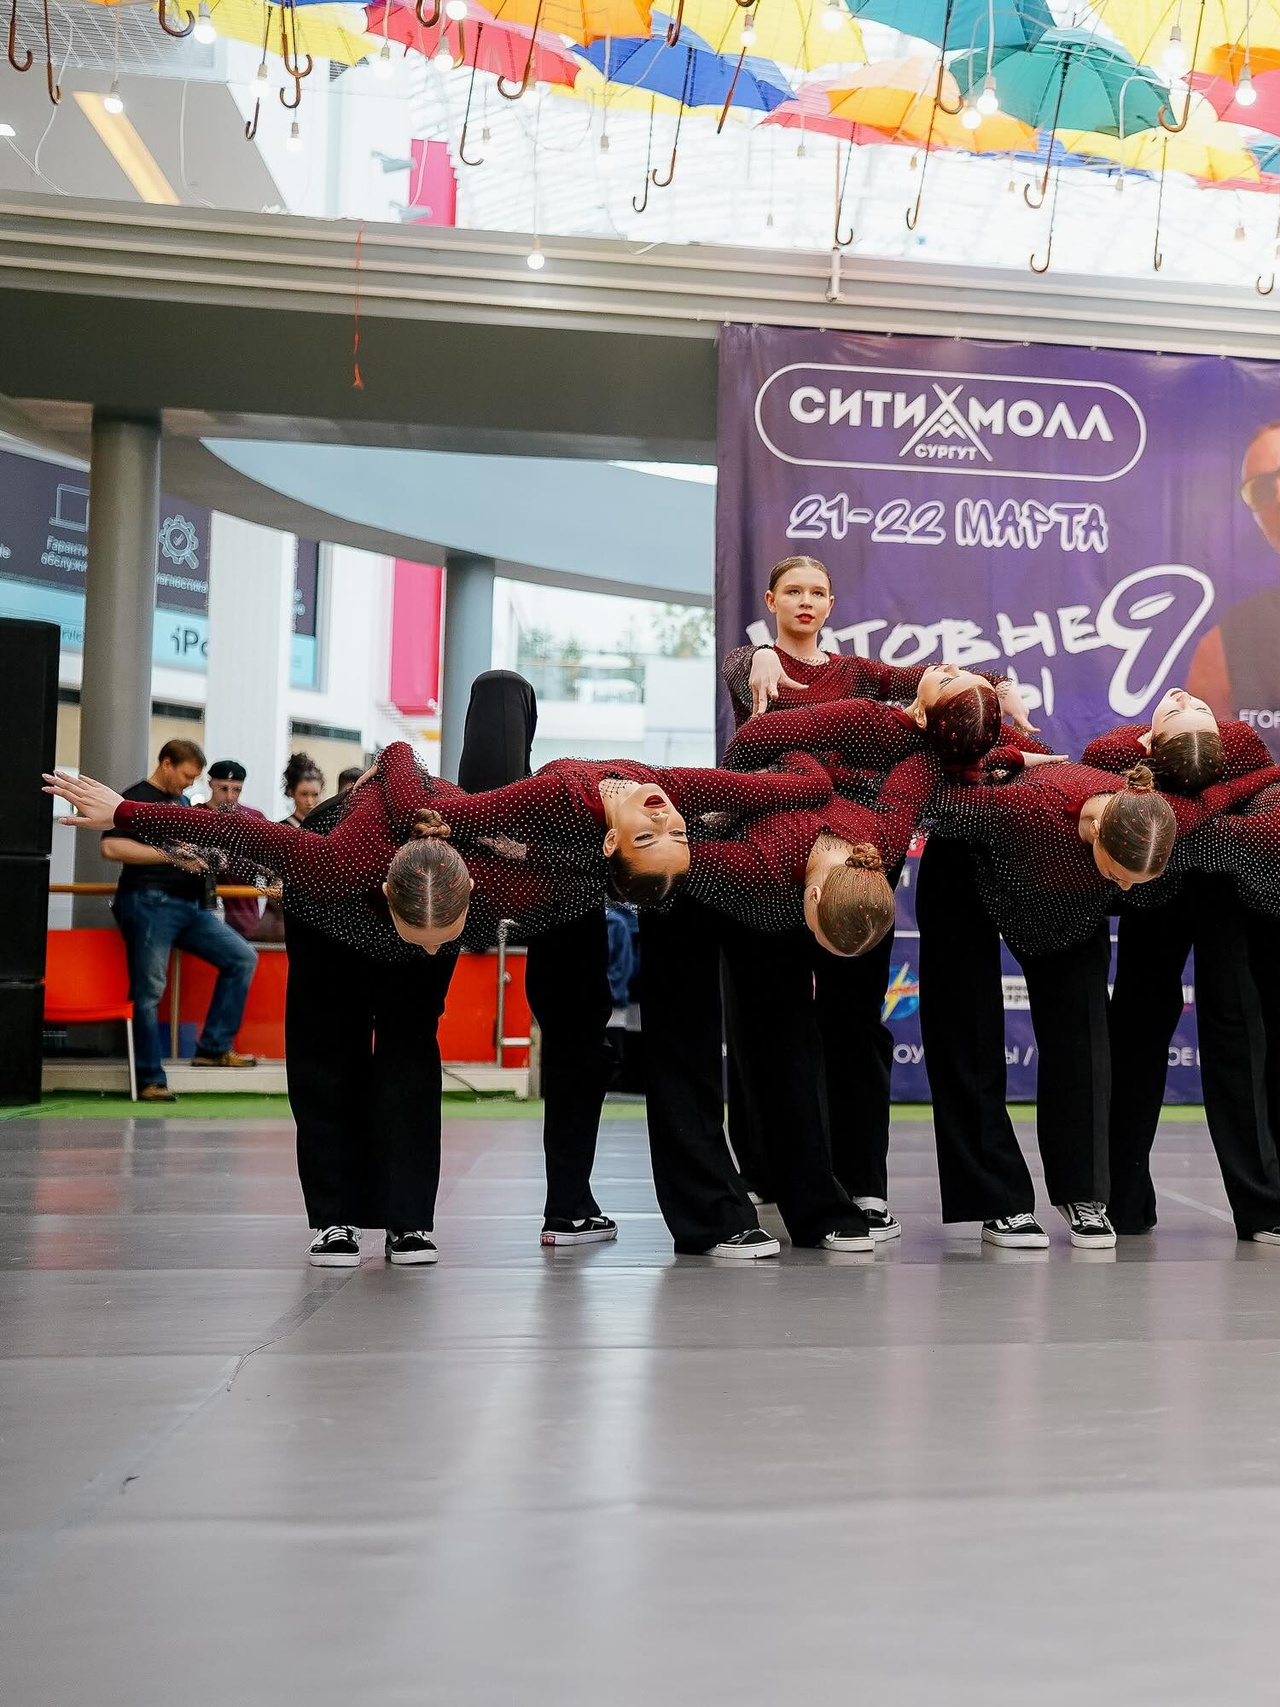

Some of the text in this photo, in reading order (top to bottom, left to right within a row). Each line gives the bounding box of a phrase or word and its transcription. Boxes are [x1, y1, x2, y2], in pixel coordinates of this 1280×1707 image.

[788, 385, 1115, 442] СИТИ МОЛЛ
[914, 443, 980, 461] СУРГУТ
[785, 492, 1109, 553] 21-22 МАРТА
[745, 605, 1101, 667] ТОВЫЕ
